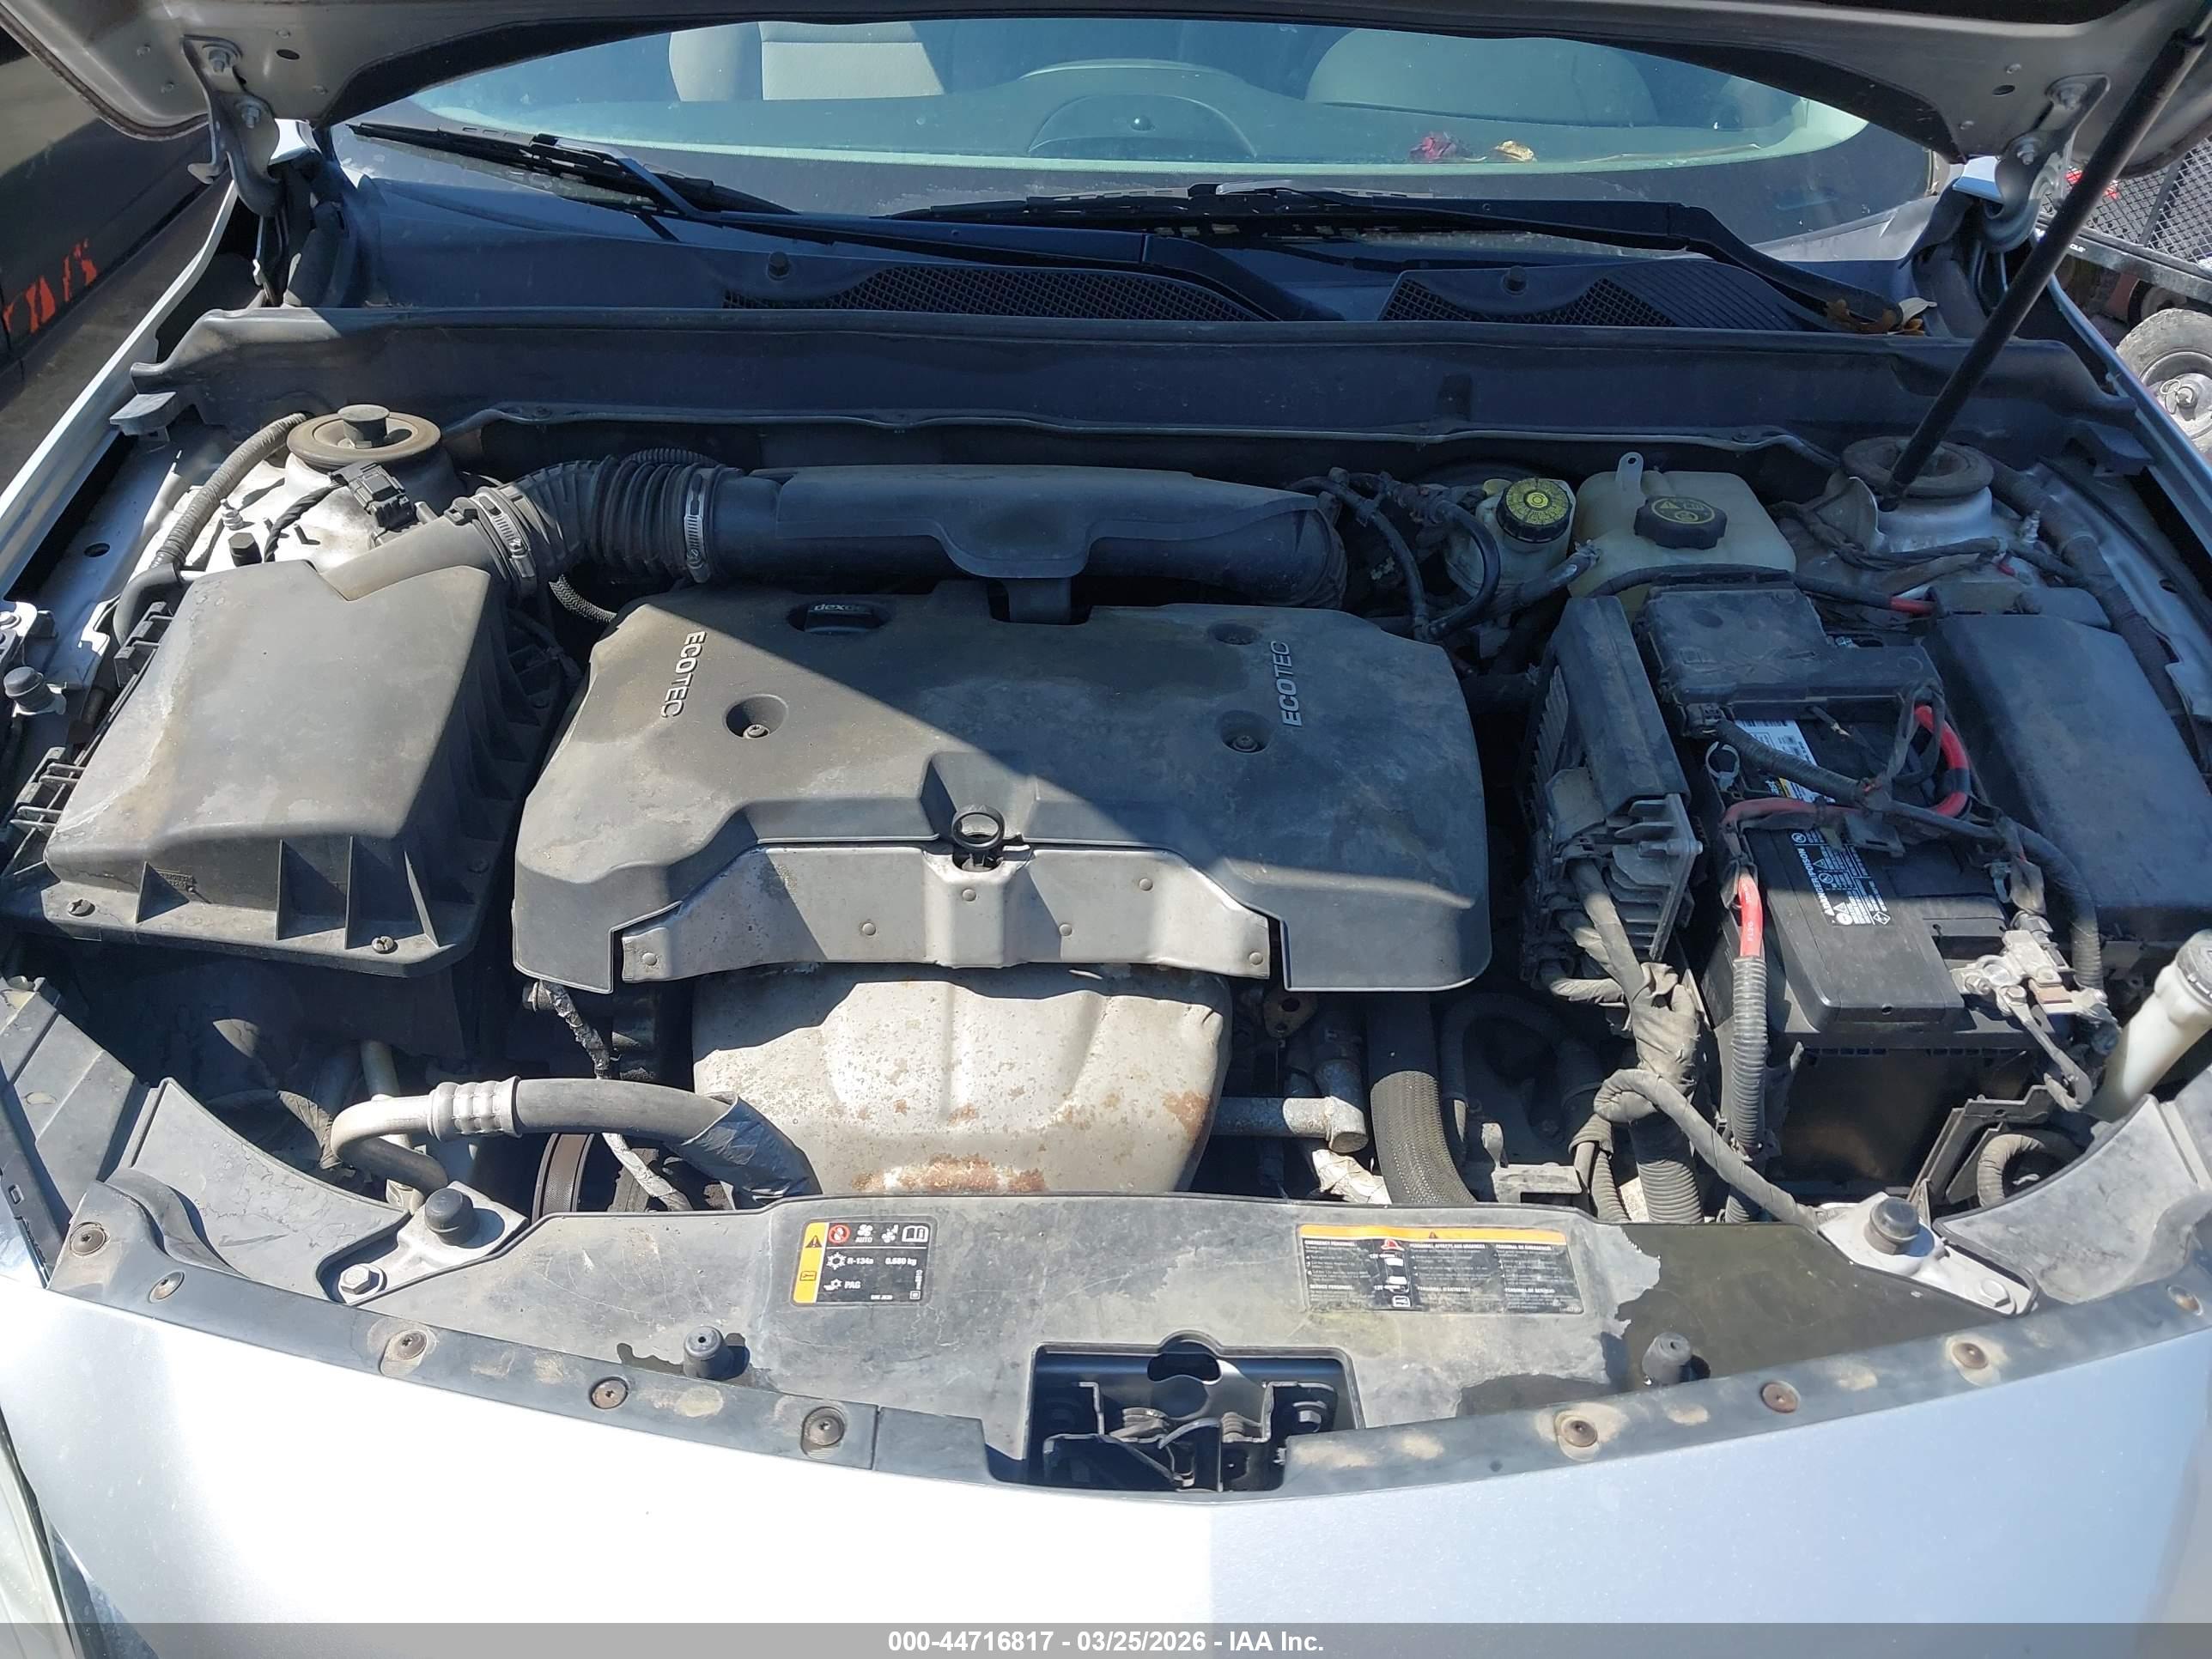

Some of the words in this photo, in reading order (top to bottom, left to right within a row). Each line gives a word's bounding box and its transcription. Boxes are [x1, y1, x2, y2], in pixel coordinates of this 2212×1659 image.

[660, 631, 706, 718] ECOTEC
[1271, 641, 1303, 726] ECOTEC
[844, 1280, 861, 1289] PAG
[907, 1257, 917, 1267] kg
